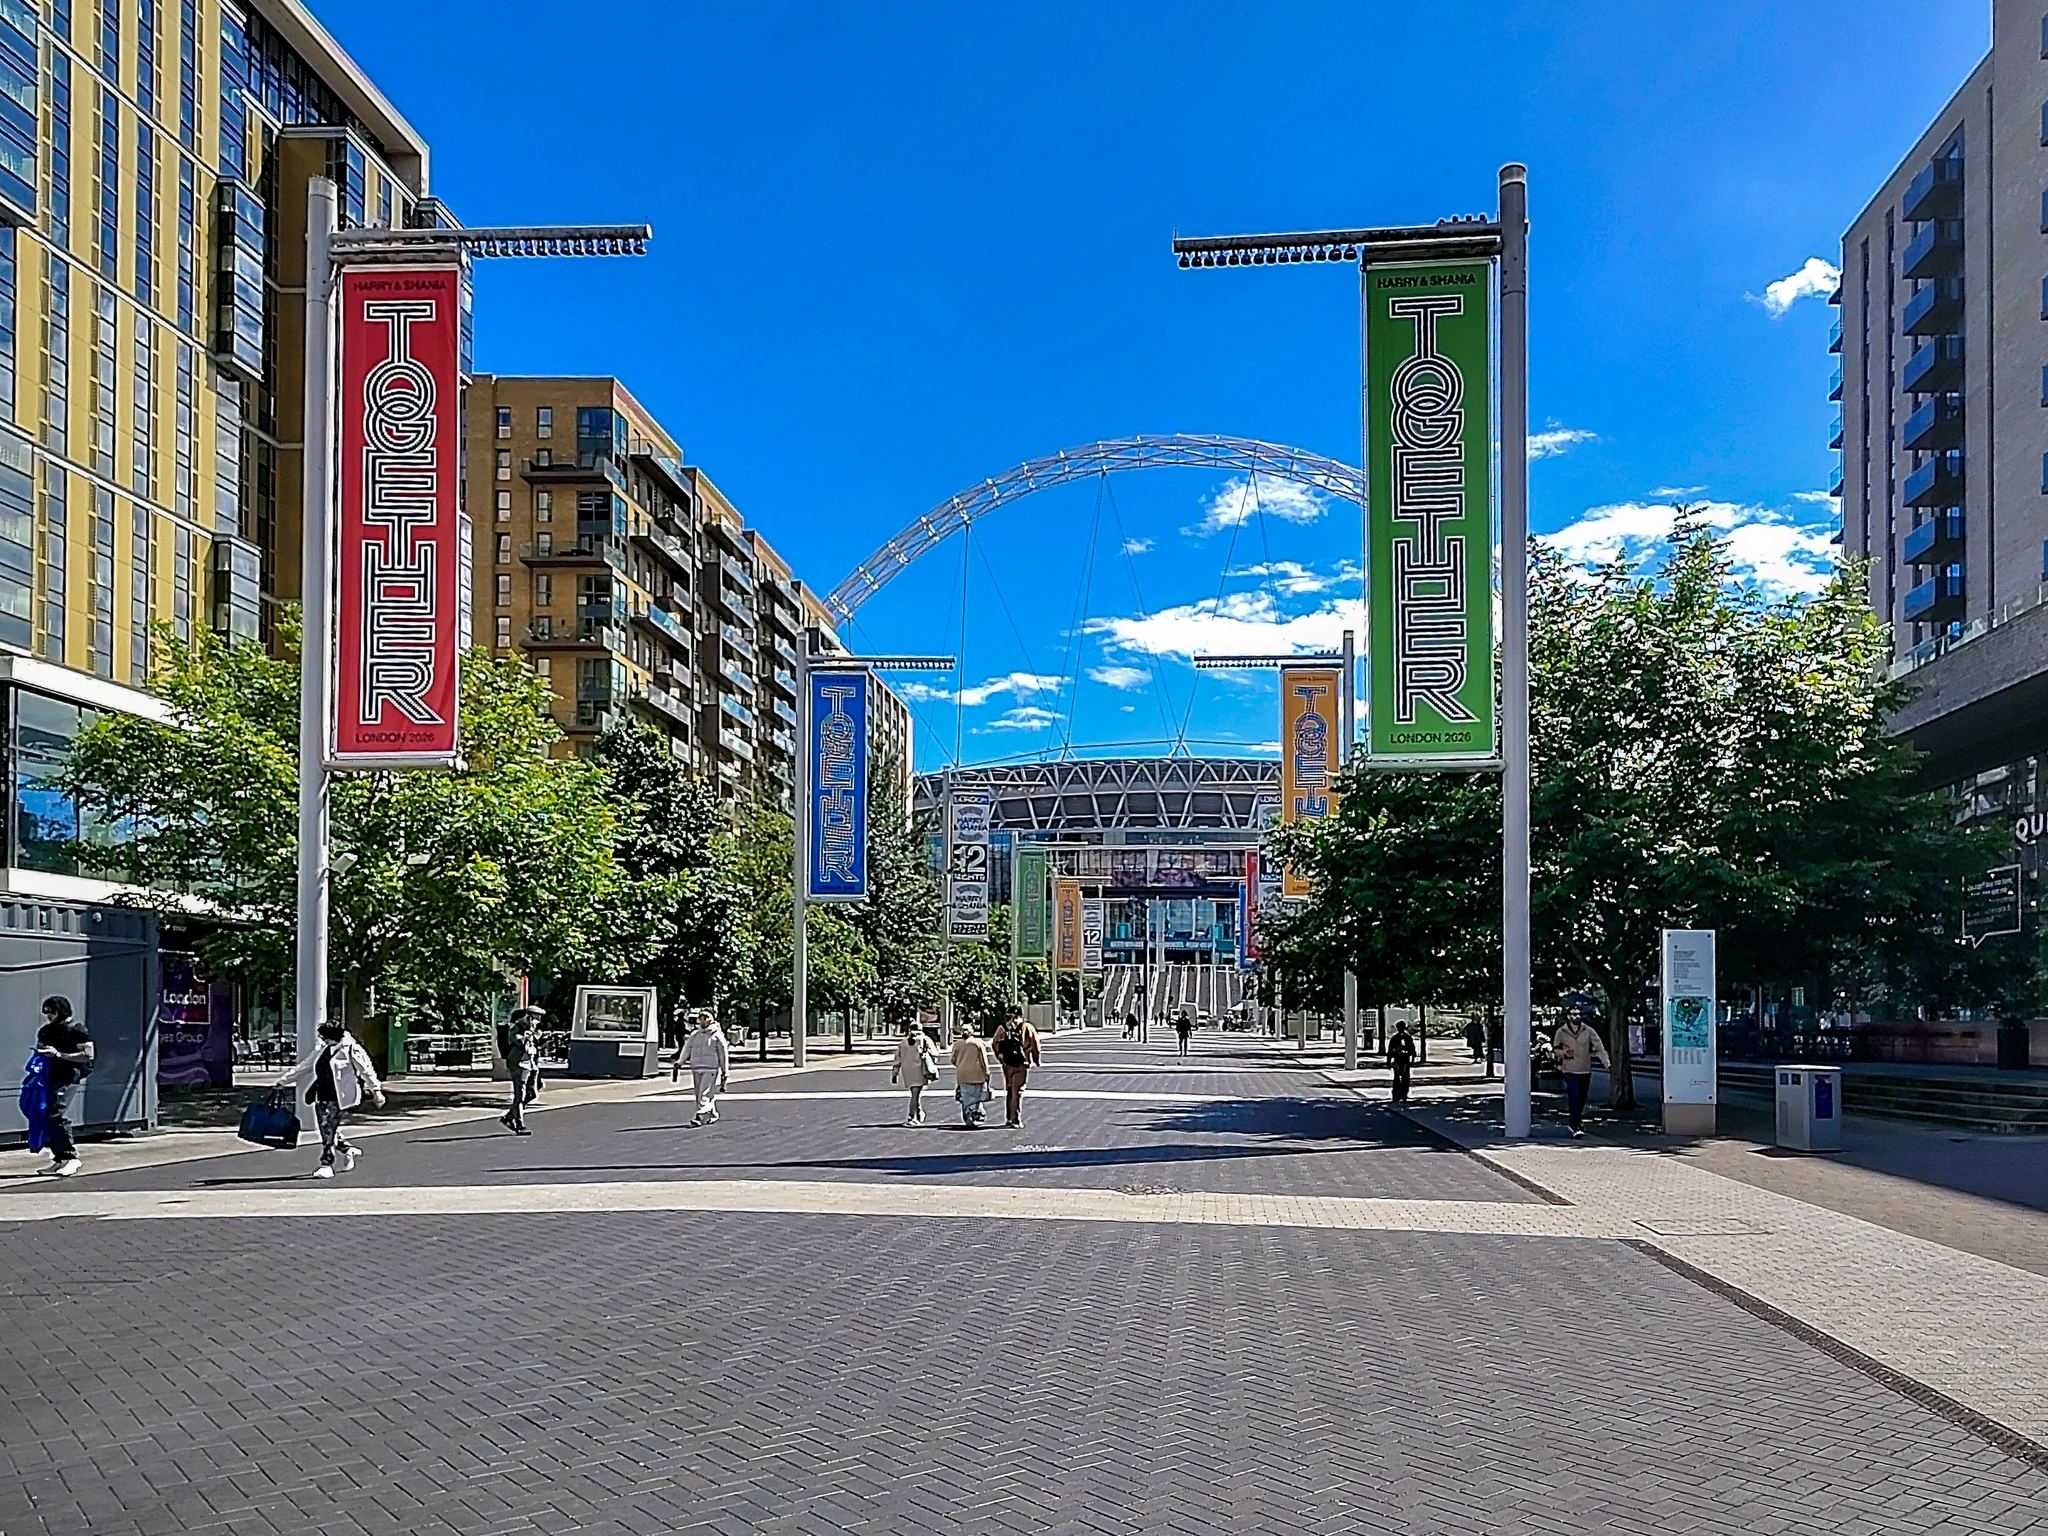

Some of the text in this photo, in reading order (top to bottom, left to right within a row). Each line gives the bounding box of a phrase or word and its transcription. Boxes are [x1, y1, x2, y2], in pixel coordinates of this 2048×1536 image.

[1378, 273, 1476, 288] HARRY & SHANIA
[359, 300, 446, 724] TOGETHER
[1389, 294, 1480, 724] TOGETHER
[355, 733, 405, 743] LONDON
[1390, 733, 1441, 743] LONDON
[2016, 813, 2048, 842] QU
[954, 845, 986, 873] 12
[1084, 931, 1101, 945] 12
[163, 989, 206, 1005] London
